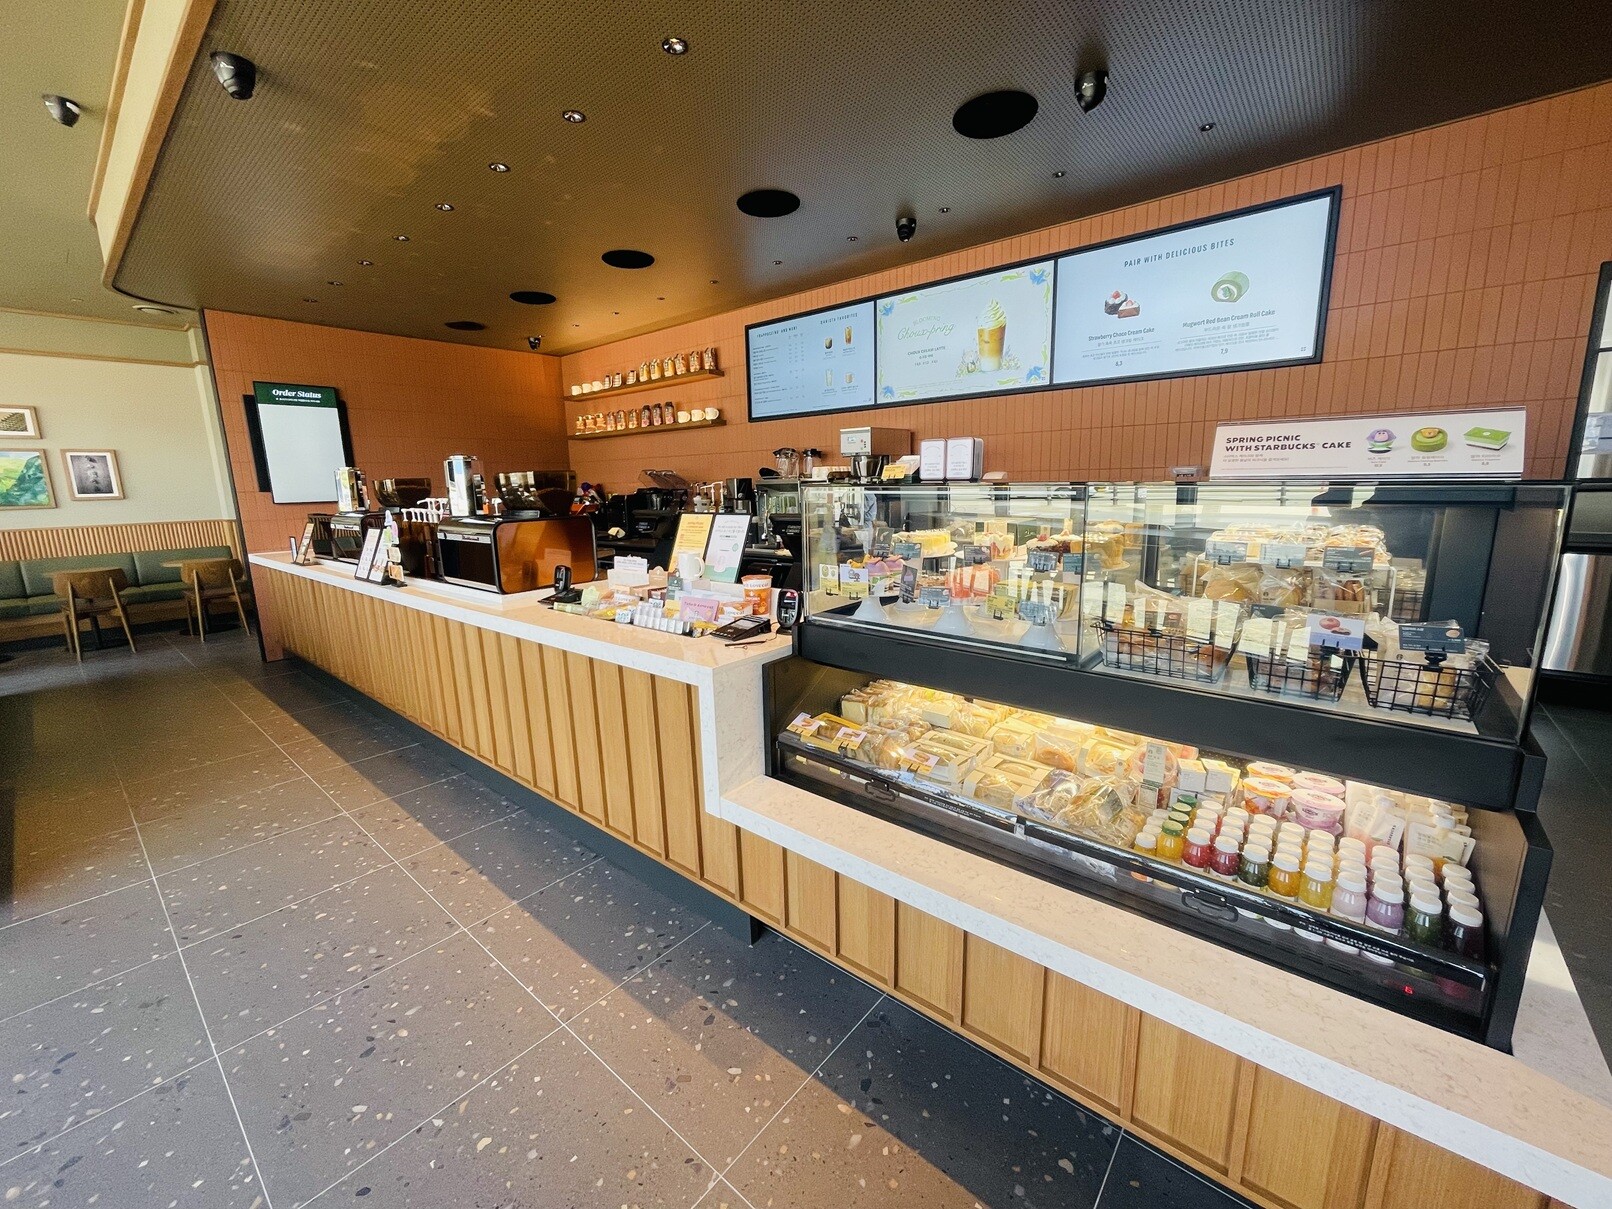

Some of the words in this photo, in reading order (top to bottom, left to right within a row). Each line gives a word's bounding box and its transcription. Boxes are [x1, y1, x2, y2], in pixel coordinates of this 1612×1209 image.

[1124, 257, 1141, 268] PAIR
[1144, 254, 1163, 264] WITH
[1165, 244, 1208, 260] DELICIOUS
[1210, 238, 1235, 251] BITES
[1182, 319, 1205, 328] Mugwort
[1206, 317, 1216, 325] Red
[1231, 313, 1249, 321] Cream
[1088, 333, 1112, 342] Strawberry
[272, 389, 296, 397] Order
[297, 390, 322, 398] Status
[1226, 436, 1264, 444] SPRING
[1266, 434, 1301, 442] PICNIC
[1225, 444, 1252, 452] WITH
[1321, 441, 1352, 449] CAKE
